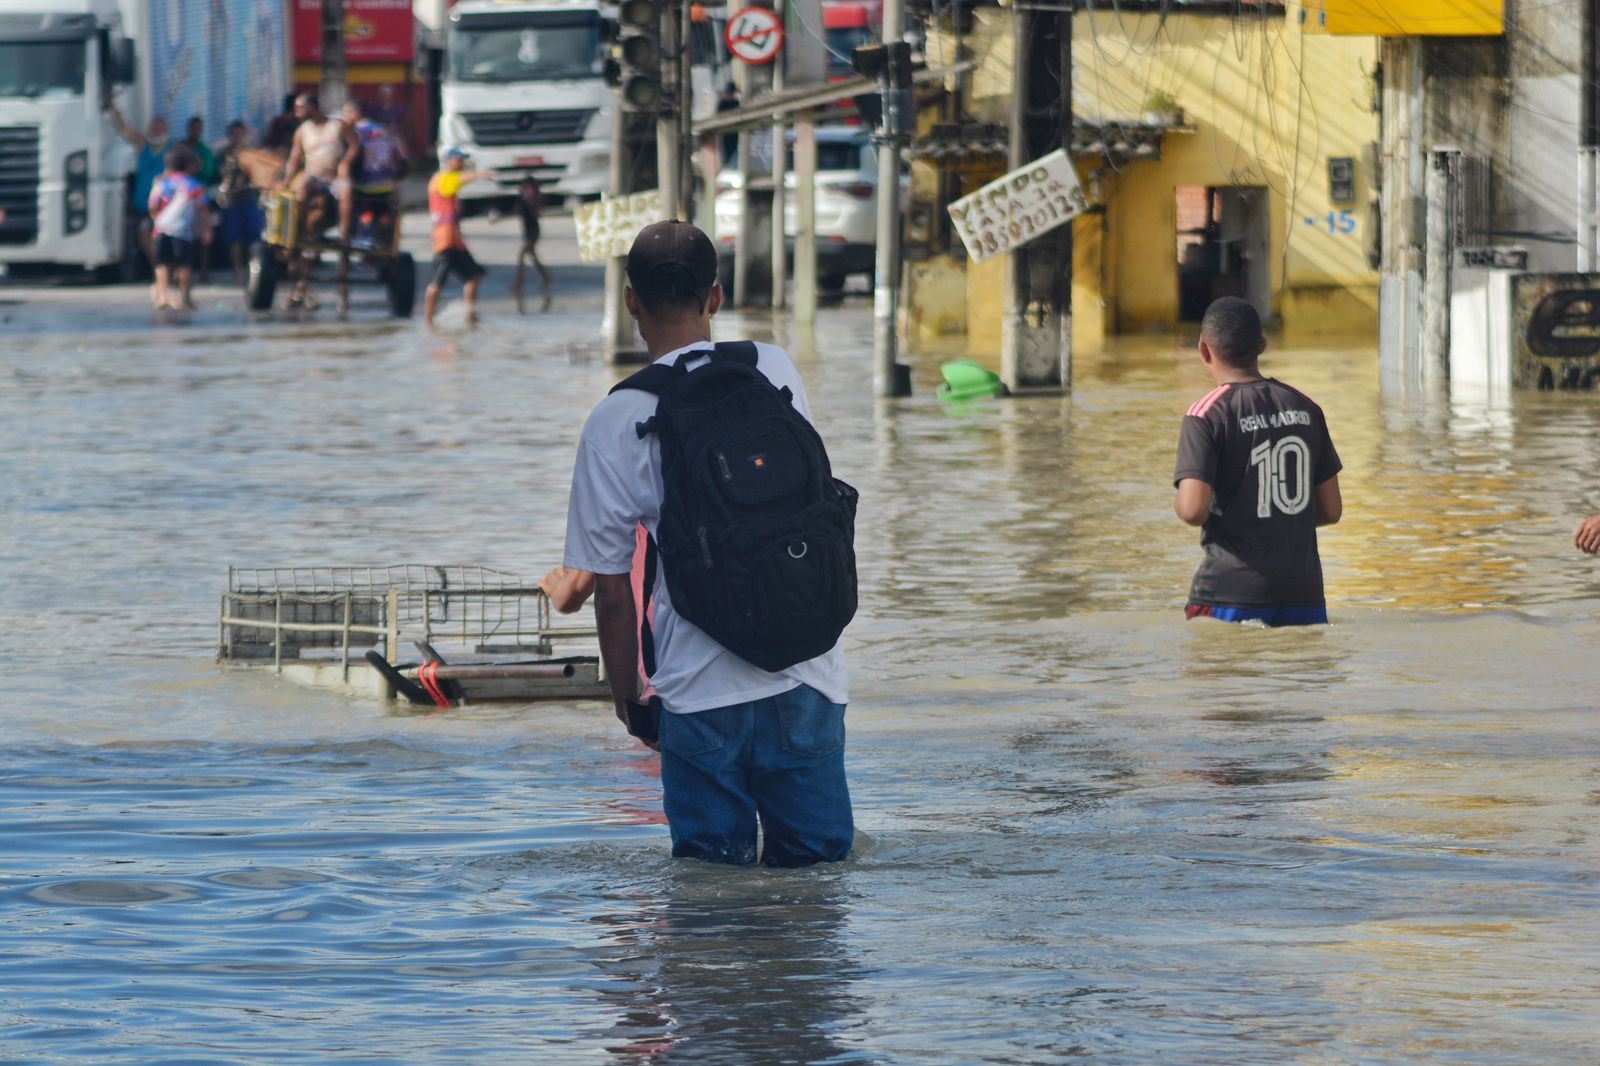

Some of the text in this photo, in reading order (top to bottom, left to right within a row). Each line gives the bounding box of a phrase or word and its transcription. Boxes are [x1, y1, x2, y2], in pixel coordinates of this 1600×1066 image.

[953, 166, 1049, 221] VENDO
[1327, 208, 1357, 234] 15
[1239, 413, 1269, 433] REAL
[1250, 435, 1310, 518] 10
